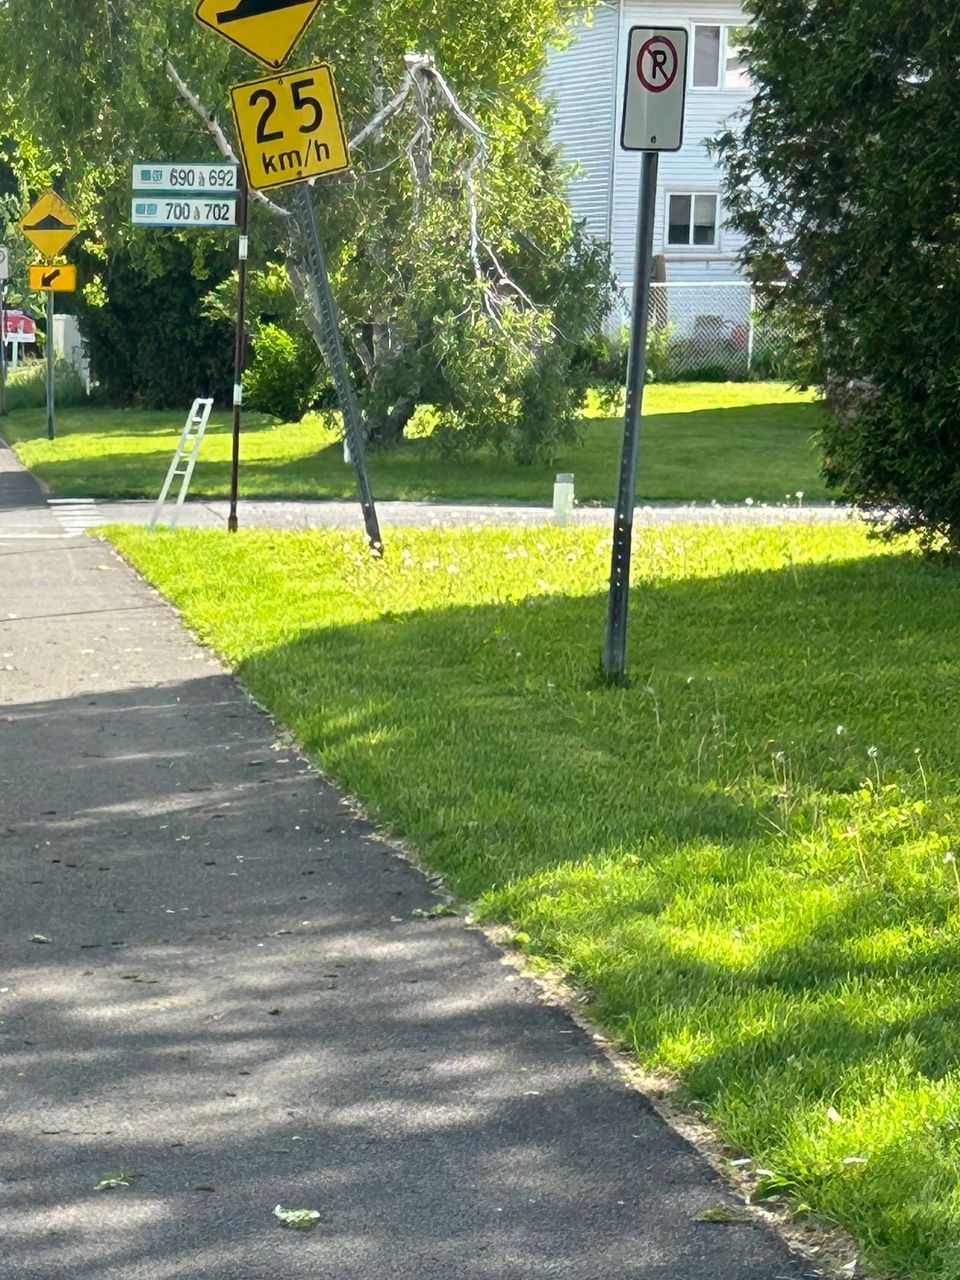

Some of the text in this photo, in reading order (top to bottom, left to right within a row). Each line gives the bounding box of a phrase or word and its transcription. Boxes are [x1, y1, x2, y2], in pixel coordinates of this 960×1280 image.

[249, 78, 323, 144] 25
[262, 139, 330, 174] km/h
[169, 168, 195, 187] 690
[209, 169, 234, 187] 692
[165, 202, 191, 220] 700
[204, 203, 230, 221] 702
